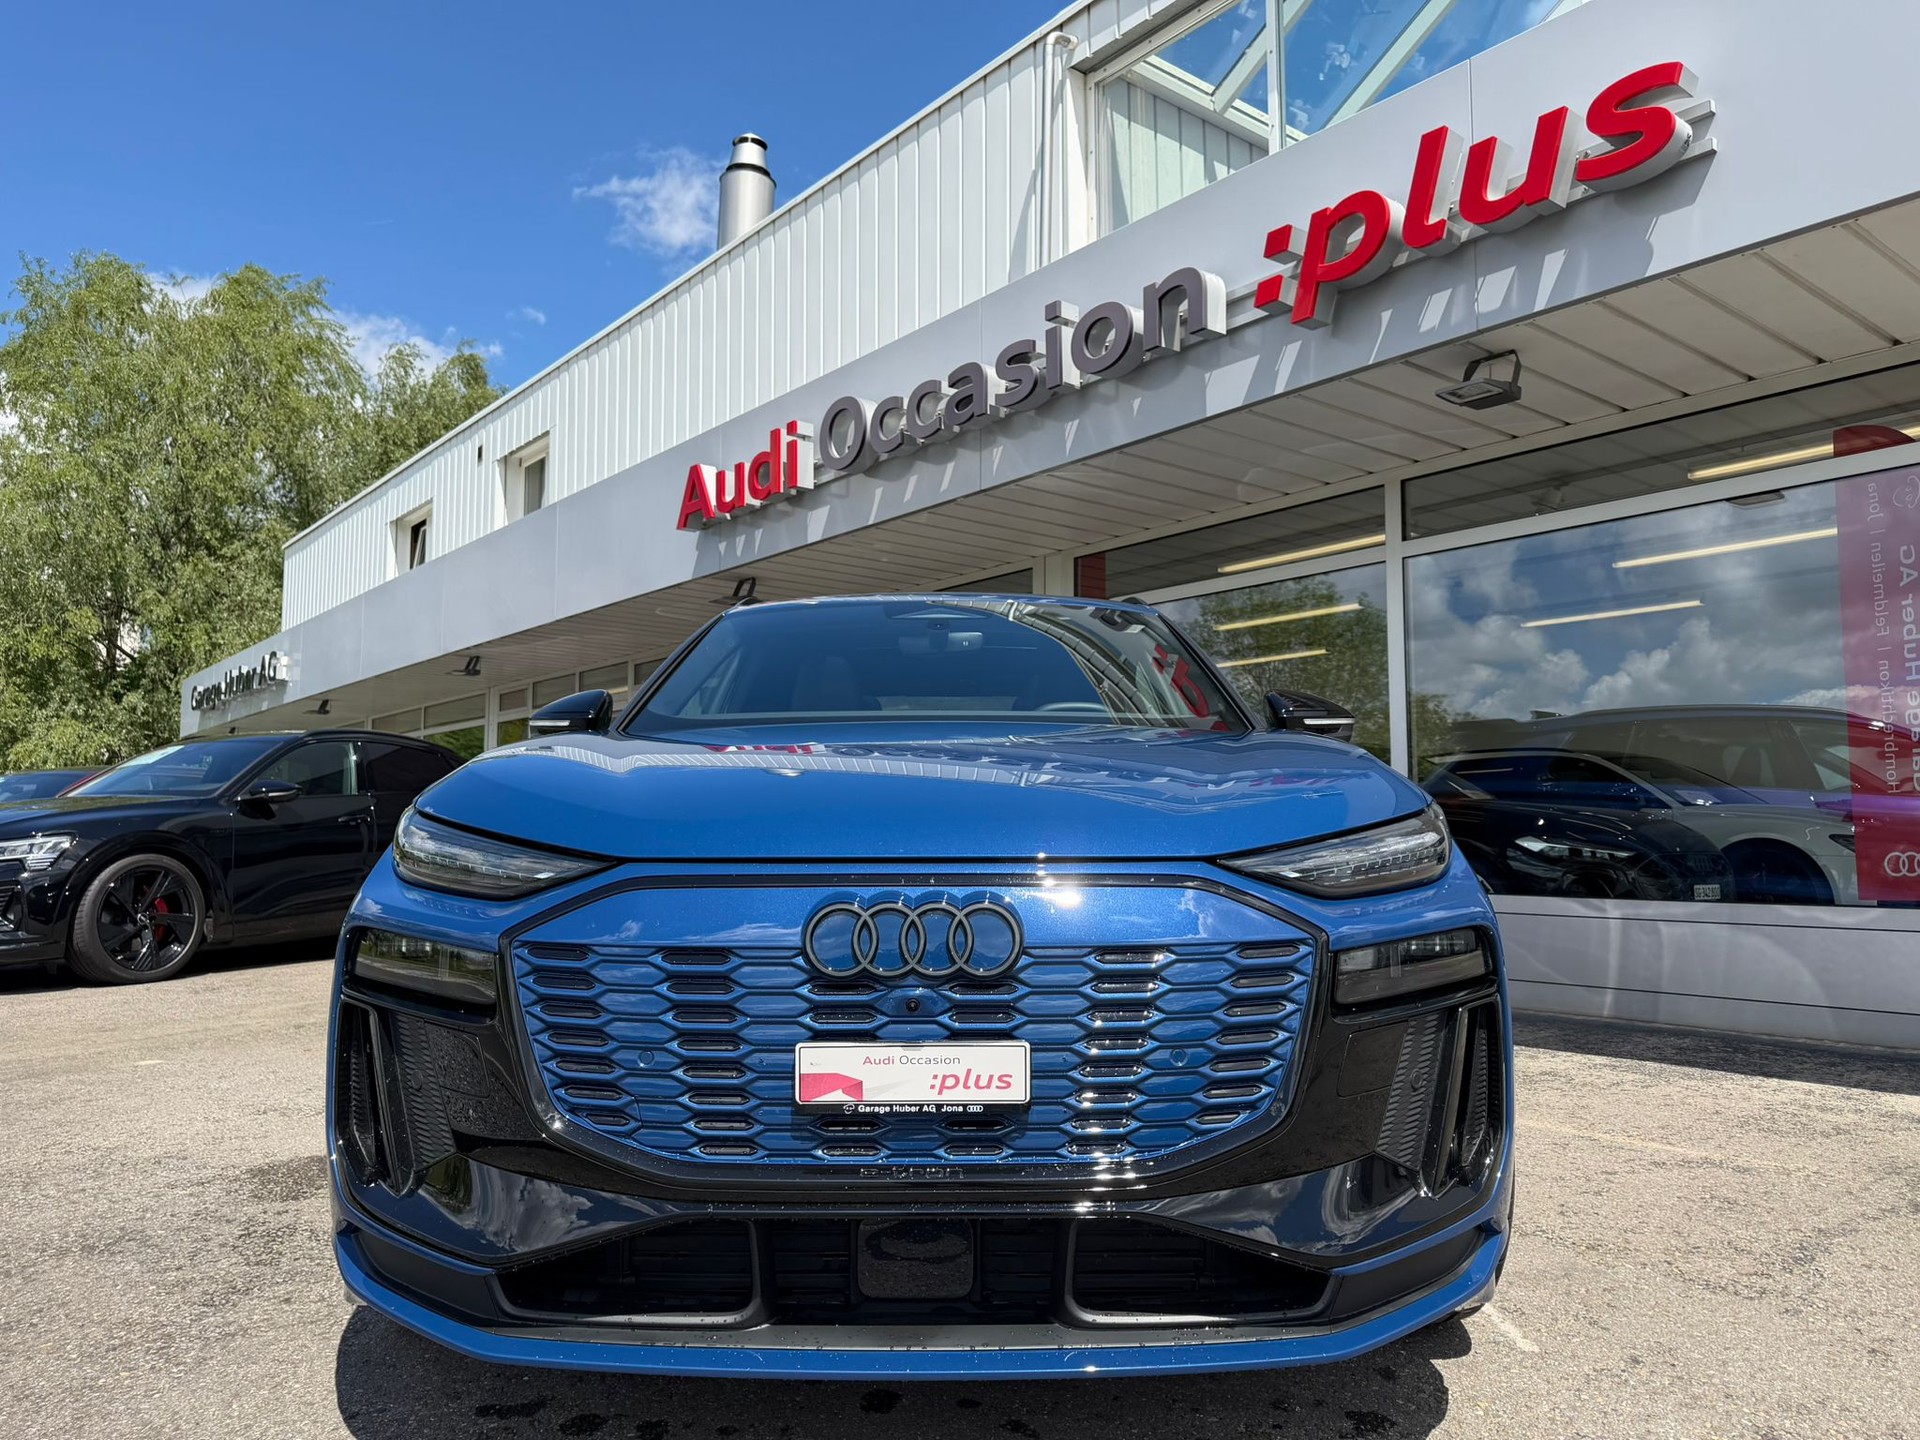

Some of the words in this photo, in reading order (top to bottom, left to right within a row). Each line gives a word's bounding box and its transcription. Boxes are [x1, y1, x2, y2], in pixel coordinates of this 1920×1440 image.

[677, 420, 800, 531] Audi
[819, 266, 1210, 471] Occasion
[1254, 61, 1685, 324] :plus
[258, 650, 277, 686] AG
[863, 1055, 895, 1065] Audi
[899, 1055, 961, 1065] Occasion
[930, 1068, 1013, 1095] :plus
[858, 1104, 890, 1114] Garage
[893, 1104, 920, 1113] Huber
[922, 1104, 936, 1113] AG
[941, 1104, 963, 1113] Jona
